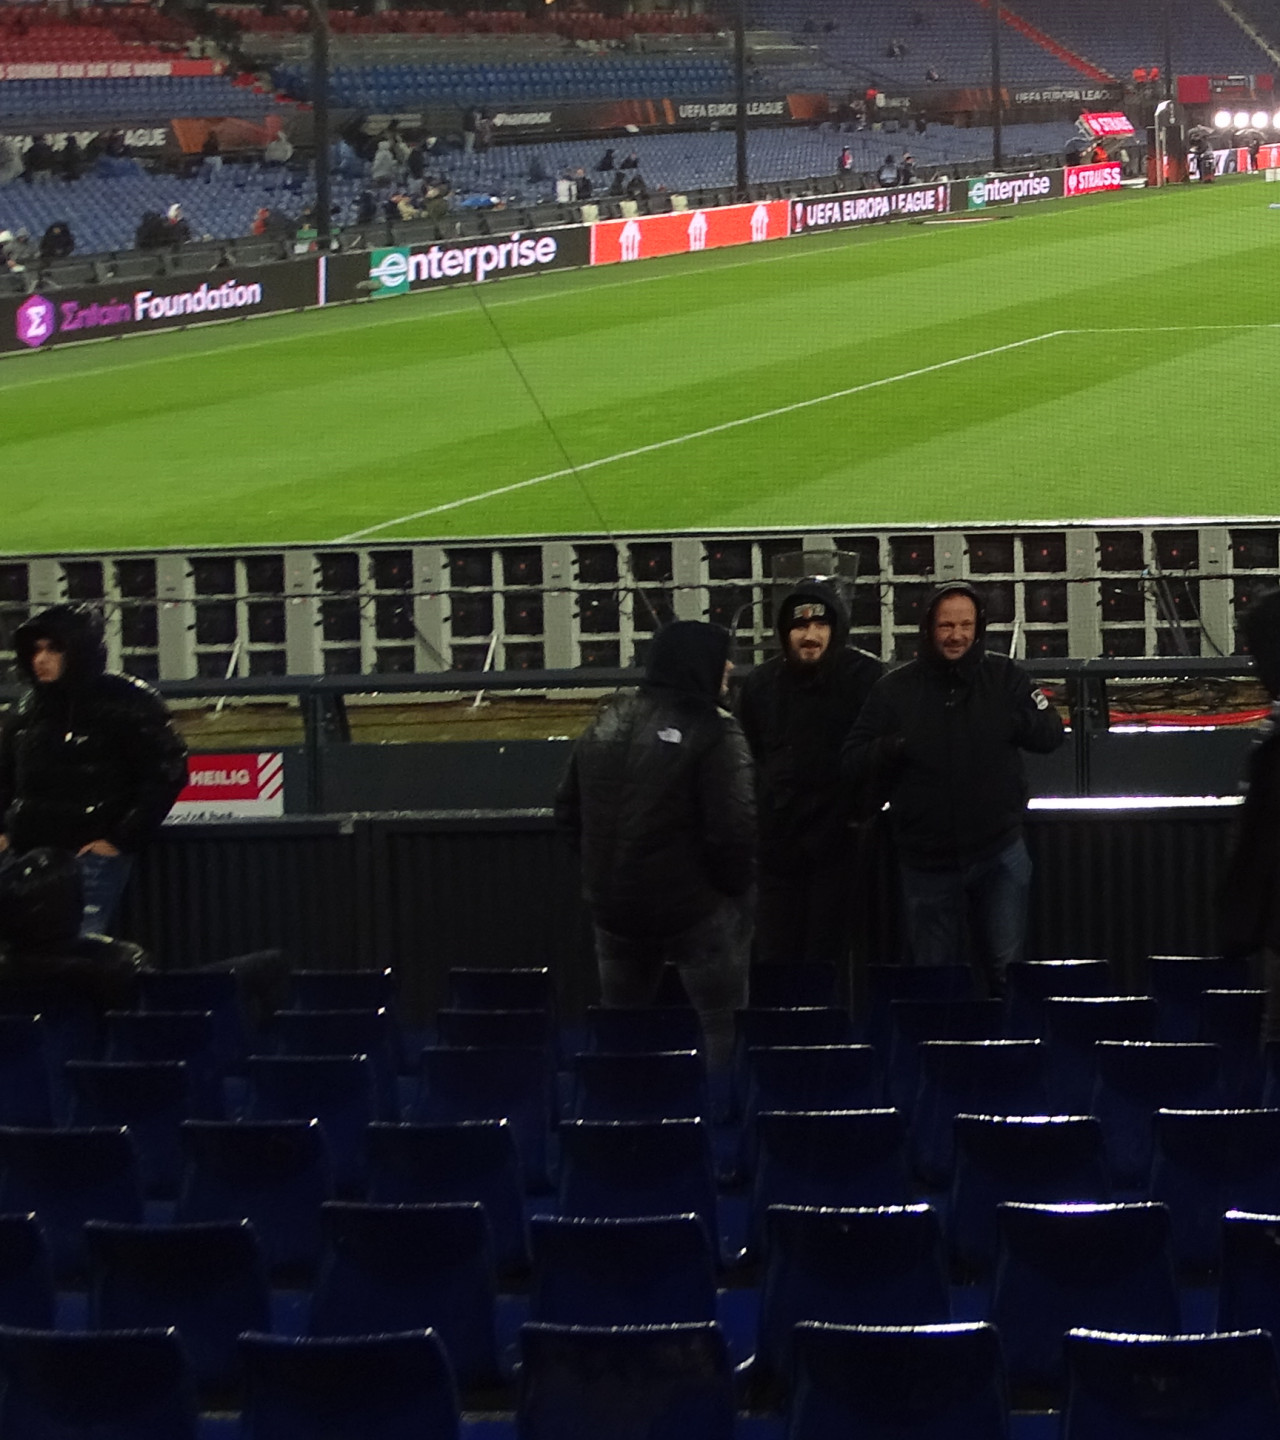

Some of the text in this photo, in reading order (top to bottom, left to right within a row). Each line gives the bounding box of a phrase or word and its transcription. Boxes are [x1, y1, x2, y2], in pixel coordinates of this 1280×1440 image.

[680, 103, 708, 118] UEFA
[746, 101, 783, 115] LEAGUE
[968, 172, 1050, 204] enterprise
[1078, 166, 1121, 189] STRAUSS
[806, 203, 842, 227] UEFA
[843, 198, 889, 222] EUROPA
[369, 232, 557, 287] enterprise
[134, 279, 262, 321] Foundation
[189, 768, 250, 786] HEILIG
